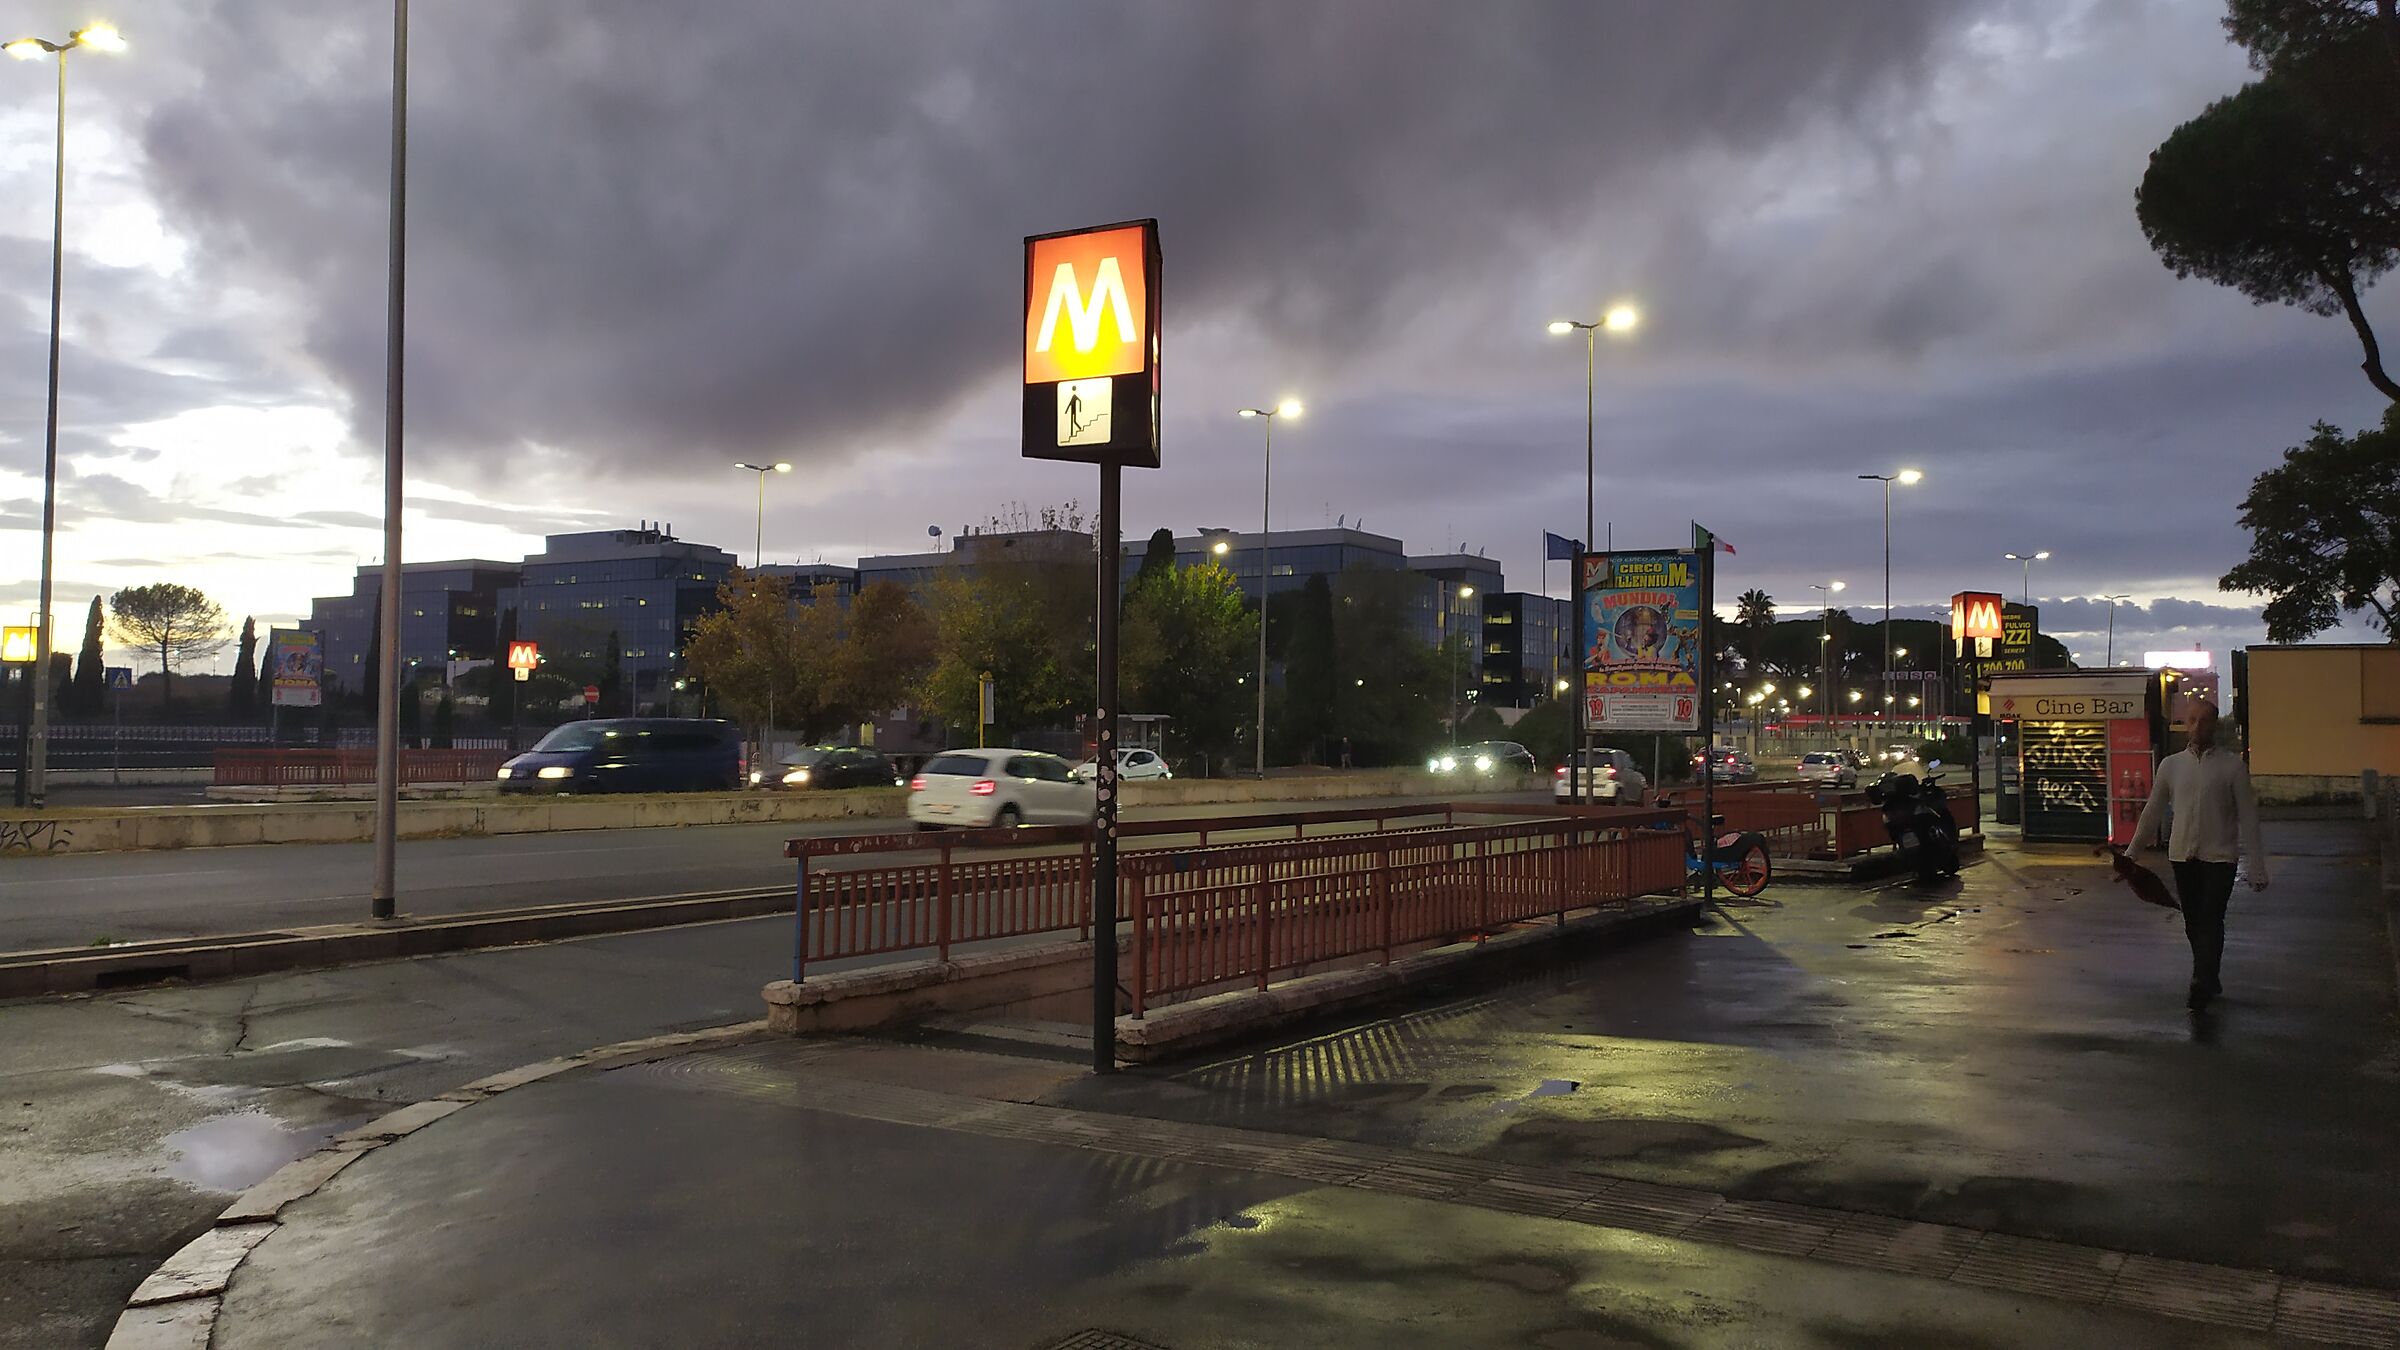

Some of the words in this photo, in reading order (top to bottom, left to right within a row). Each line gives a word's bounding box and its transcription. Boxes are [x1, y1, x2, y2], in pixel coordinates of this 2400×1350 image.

[1035, 257, 1138, 353] M
[1620, 563, 1664, 573] CIRCO
[1602, 591, 1680, 610] MUNDIAL
[1968, 601, 1999, 630] M
[511, 645, 536, 664] M
[1586, 672, 1697, 686] ROMA
[1589, 698, 1604, 717] 19
[1677, 698, 1693, 718] 10
[2035, 698, 2086, 715] Cine
[2092, 698, 2134, 714] Bar
